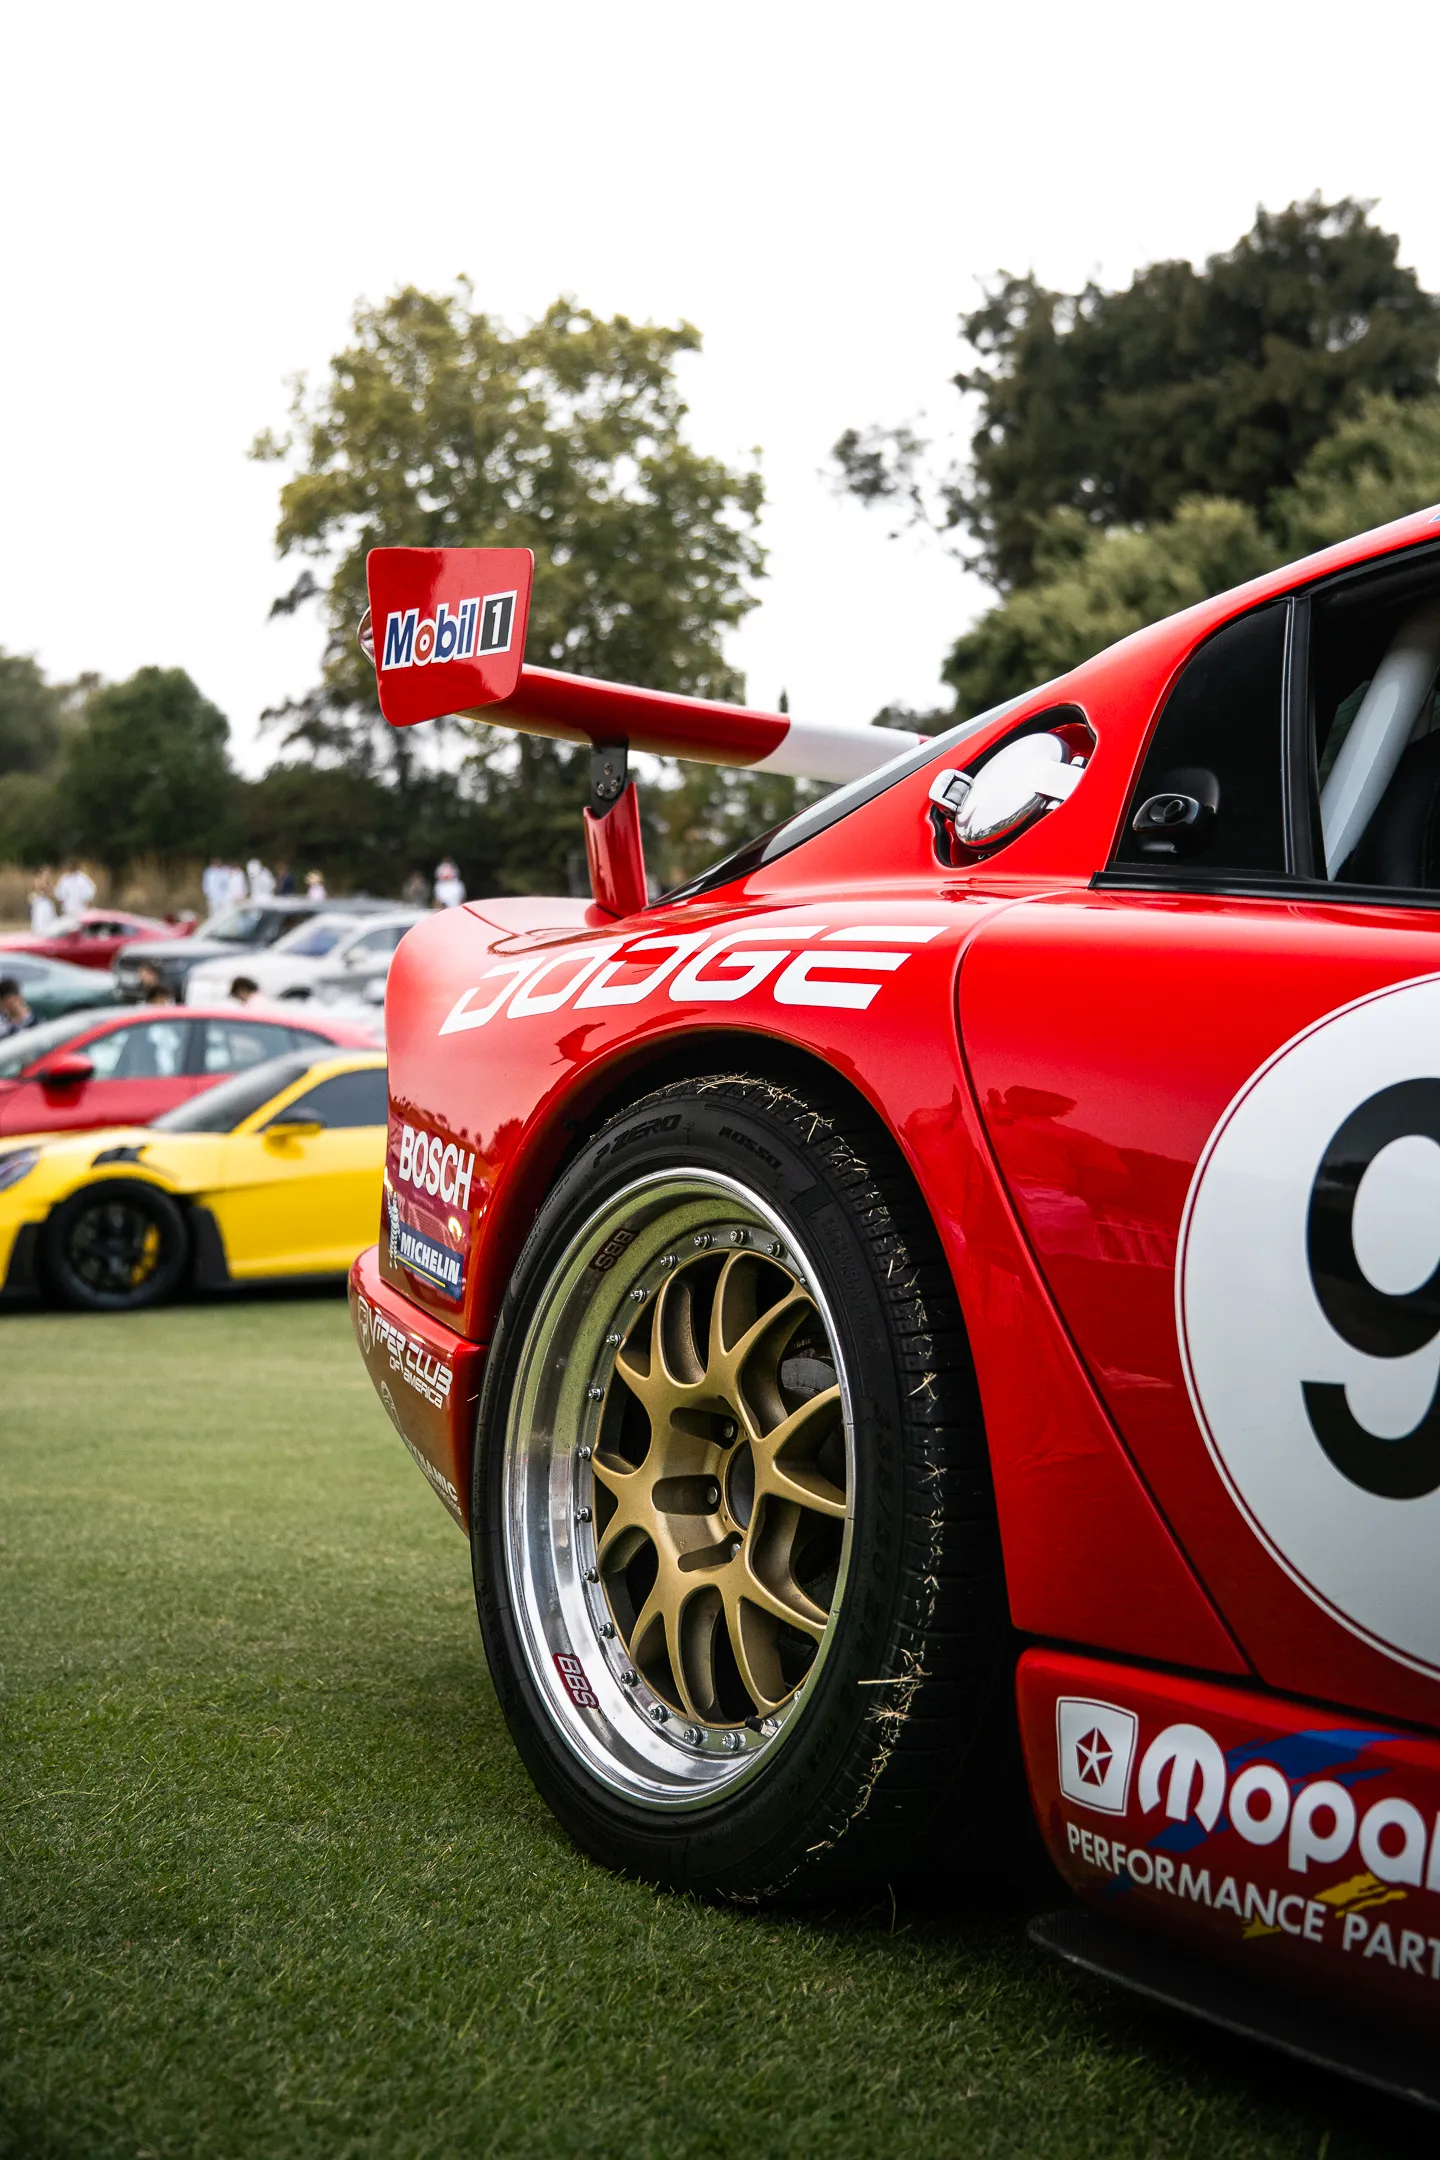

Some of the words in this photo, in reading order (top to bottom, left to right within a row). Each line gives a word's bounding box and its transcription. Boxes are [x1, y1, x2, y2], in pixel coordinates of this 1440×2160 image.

[383, 600, 478, 669] Mobil
[438, 926, 949, 1036] DODGE
[399, 1124, 475, 1211] BOSCH
[609, 1114, 683, 1143] ZERO
[718, 1126, 783, 1170] ROSSO
[400, 1231, 461, 1285] MICHELIN
[593, 1229, 635, 1272] BBS
[405, 1340, 453, 1396] CLUB
[557, 1655, 597, 1708] BBS
[1066, 1821, 1328, 1943] PERFORMANCE
